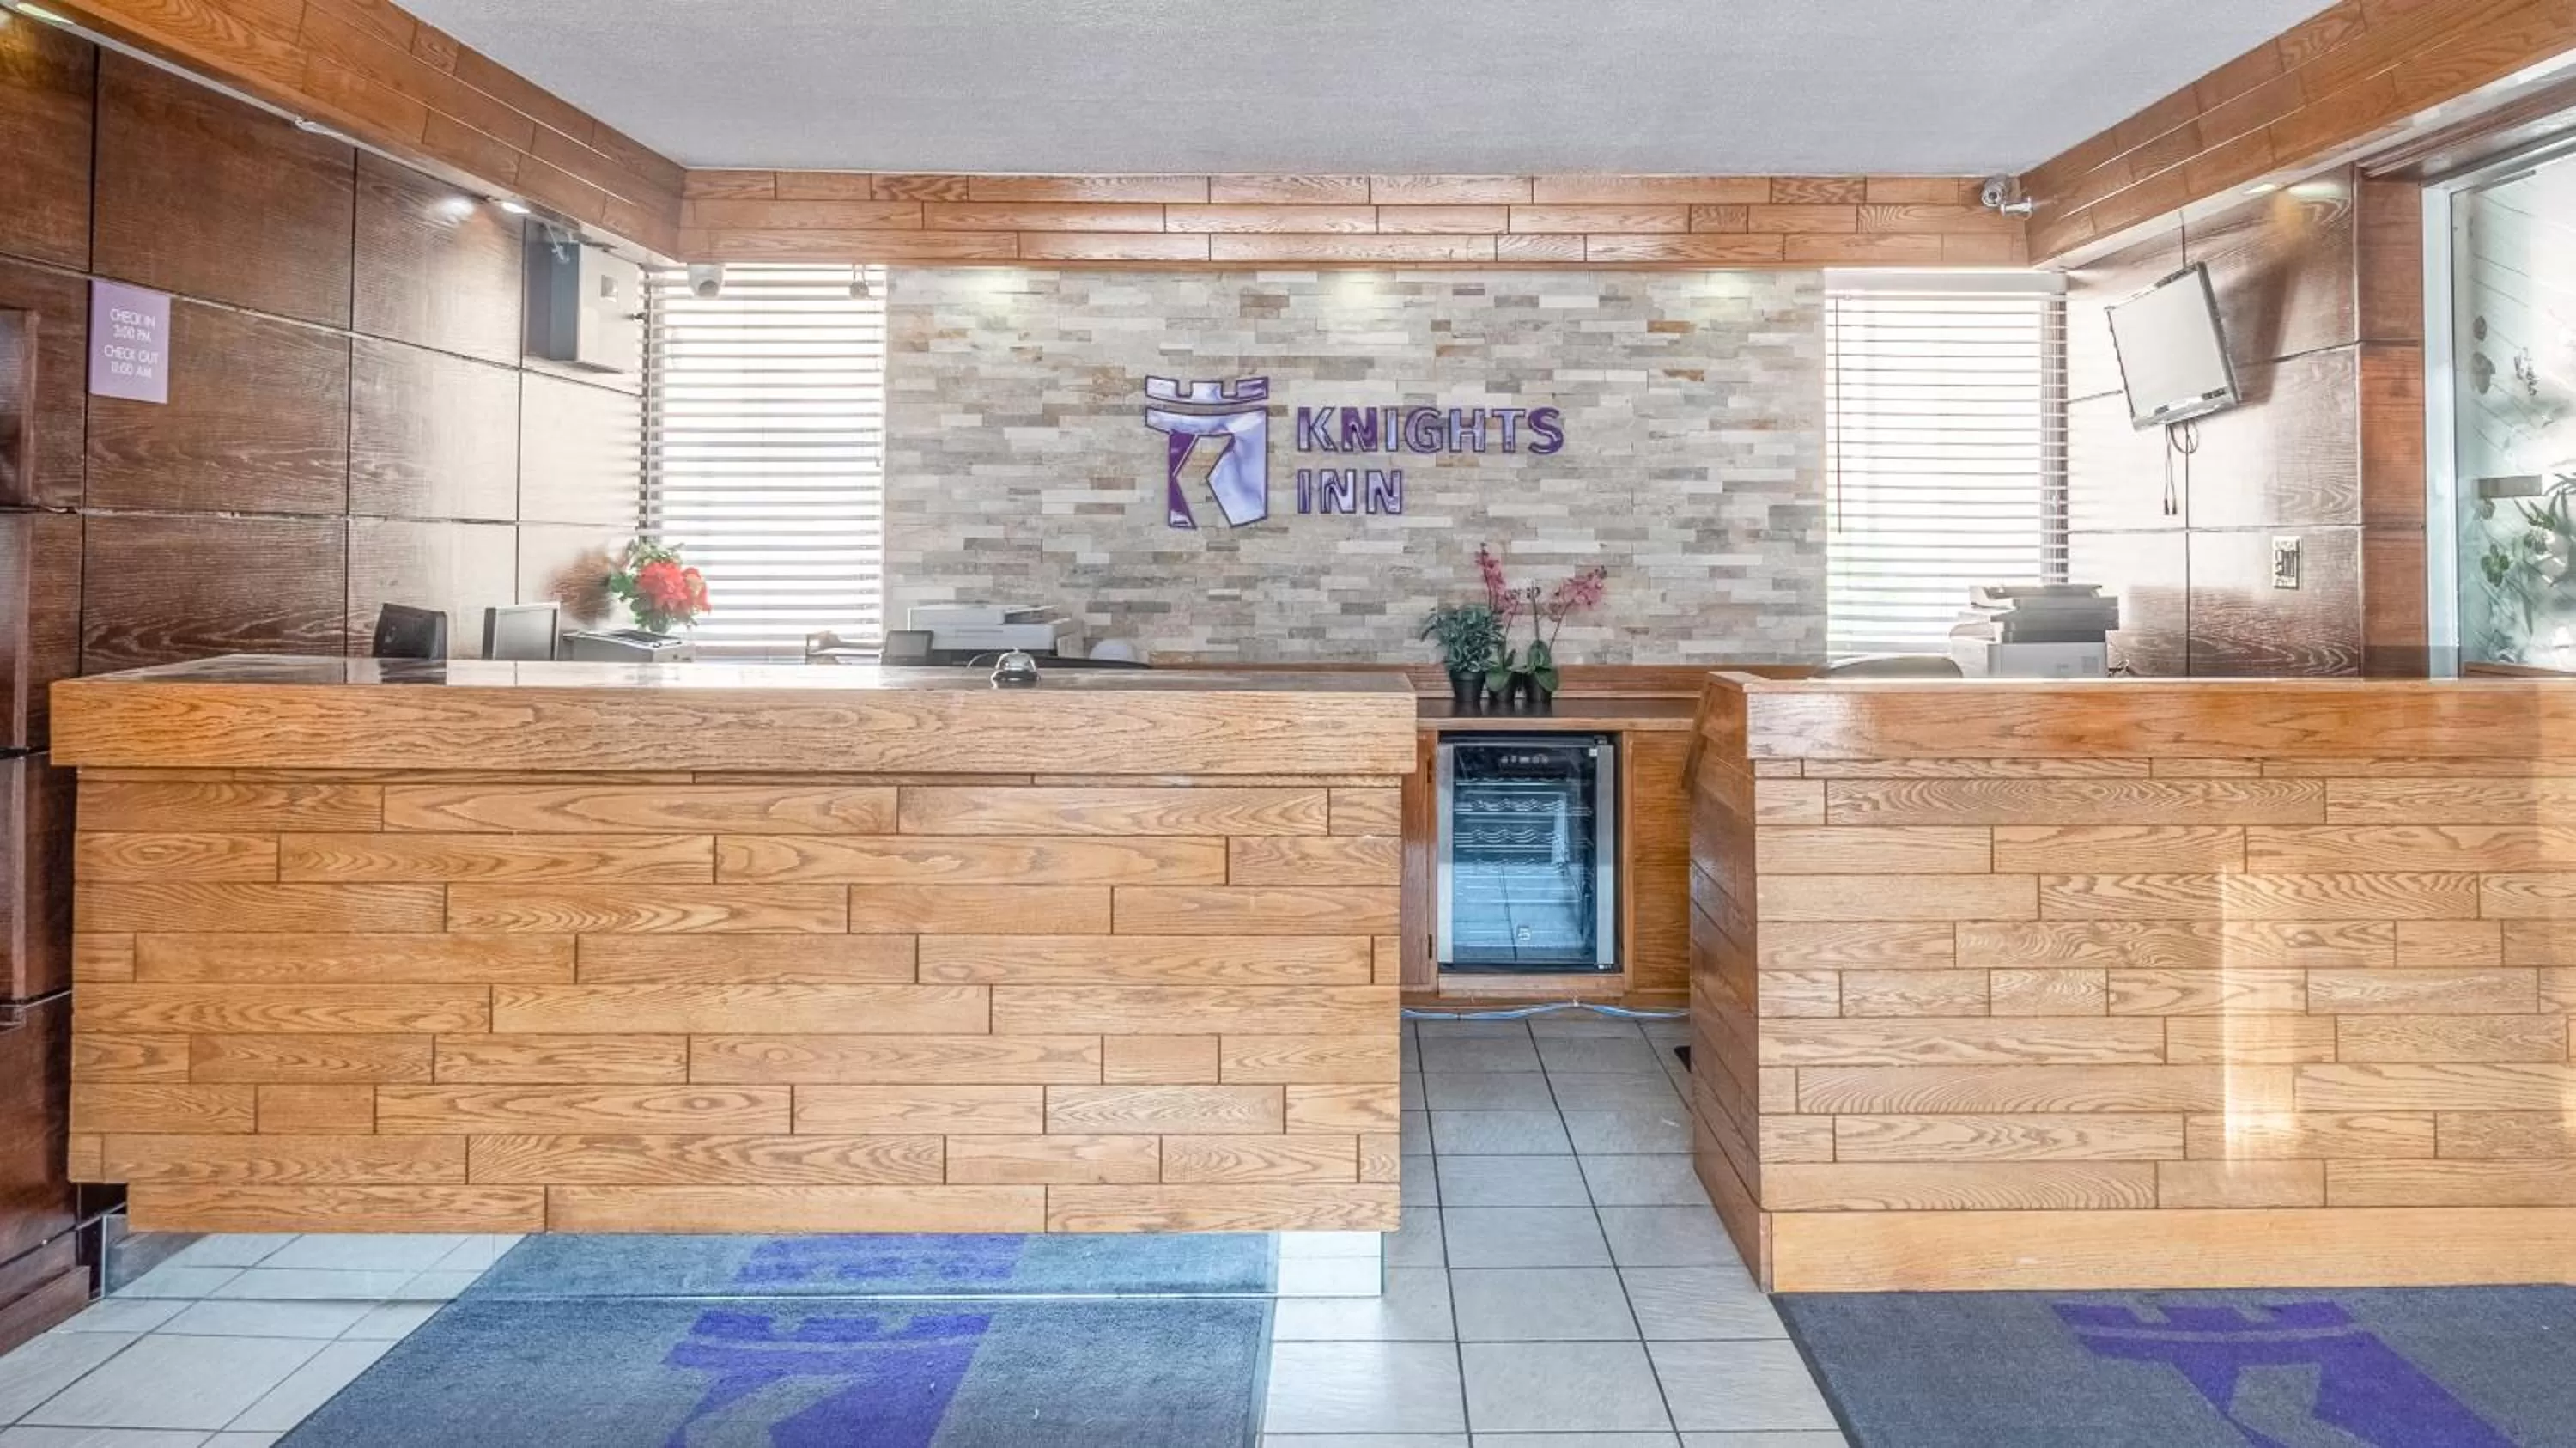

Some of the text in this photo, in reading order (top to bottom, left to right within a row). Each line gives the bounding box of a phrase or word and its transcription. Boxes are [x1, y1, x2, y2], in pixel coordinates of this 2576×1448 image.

[110, 308, 155, 330] CHECK IN
[104, 344, 160, 365] CHECK OUT
[136, 365, 152, 380] AM
[1297, 405, 1564, 455] KNIGHTS
[1297, 468, 1403, 514] INN
